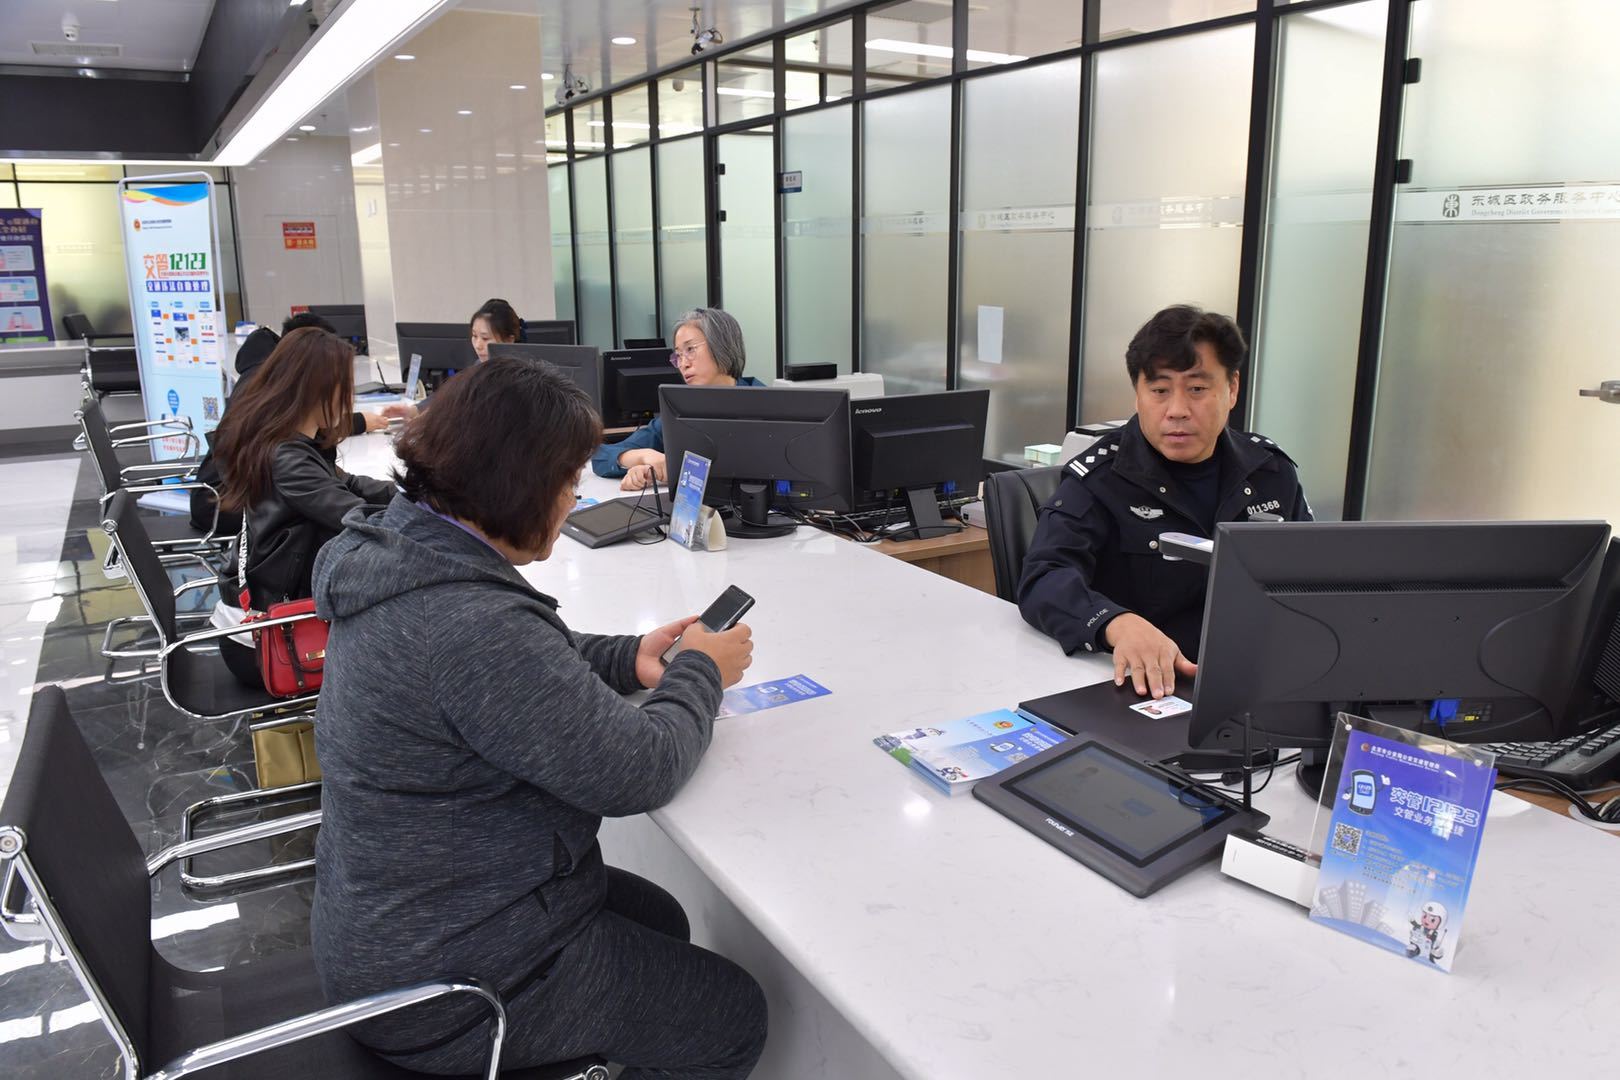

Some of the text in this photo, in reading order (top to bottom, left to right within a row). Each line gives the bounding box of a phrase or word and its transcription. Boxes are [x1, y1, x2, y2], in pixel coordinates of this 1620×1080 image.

[1471, 190, 1620, 207] 东城区政务服务中心
[855, 407, 883, 415] lenovo
[1246, 499, 1280, 515] 011368
[1086, 607, 1109, 628] POLICE
[1389, 786, 1480, 828] 交管12123
